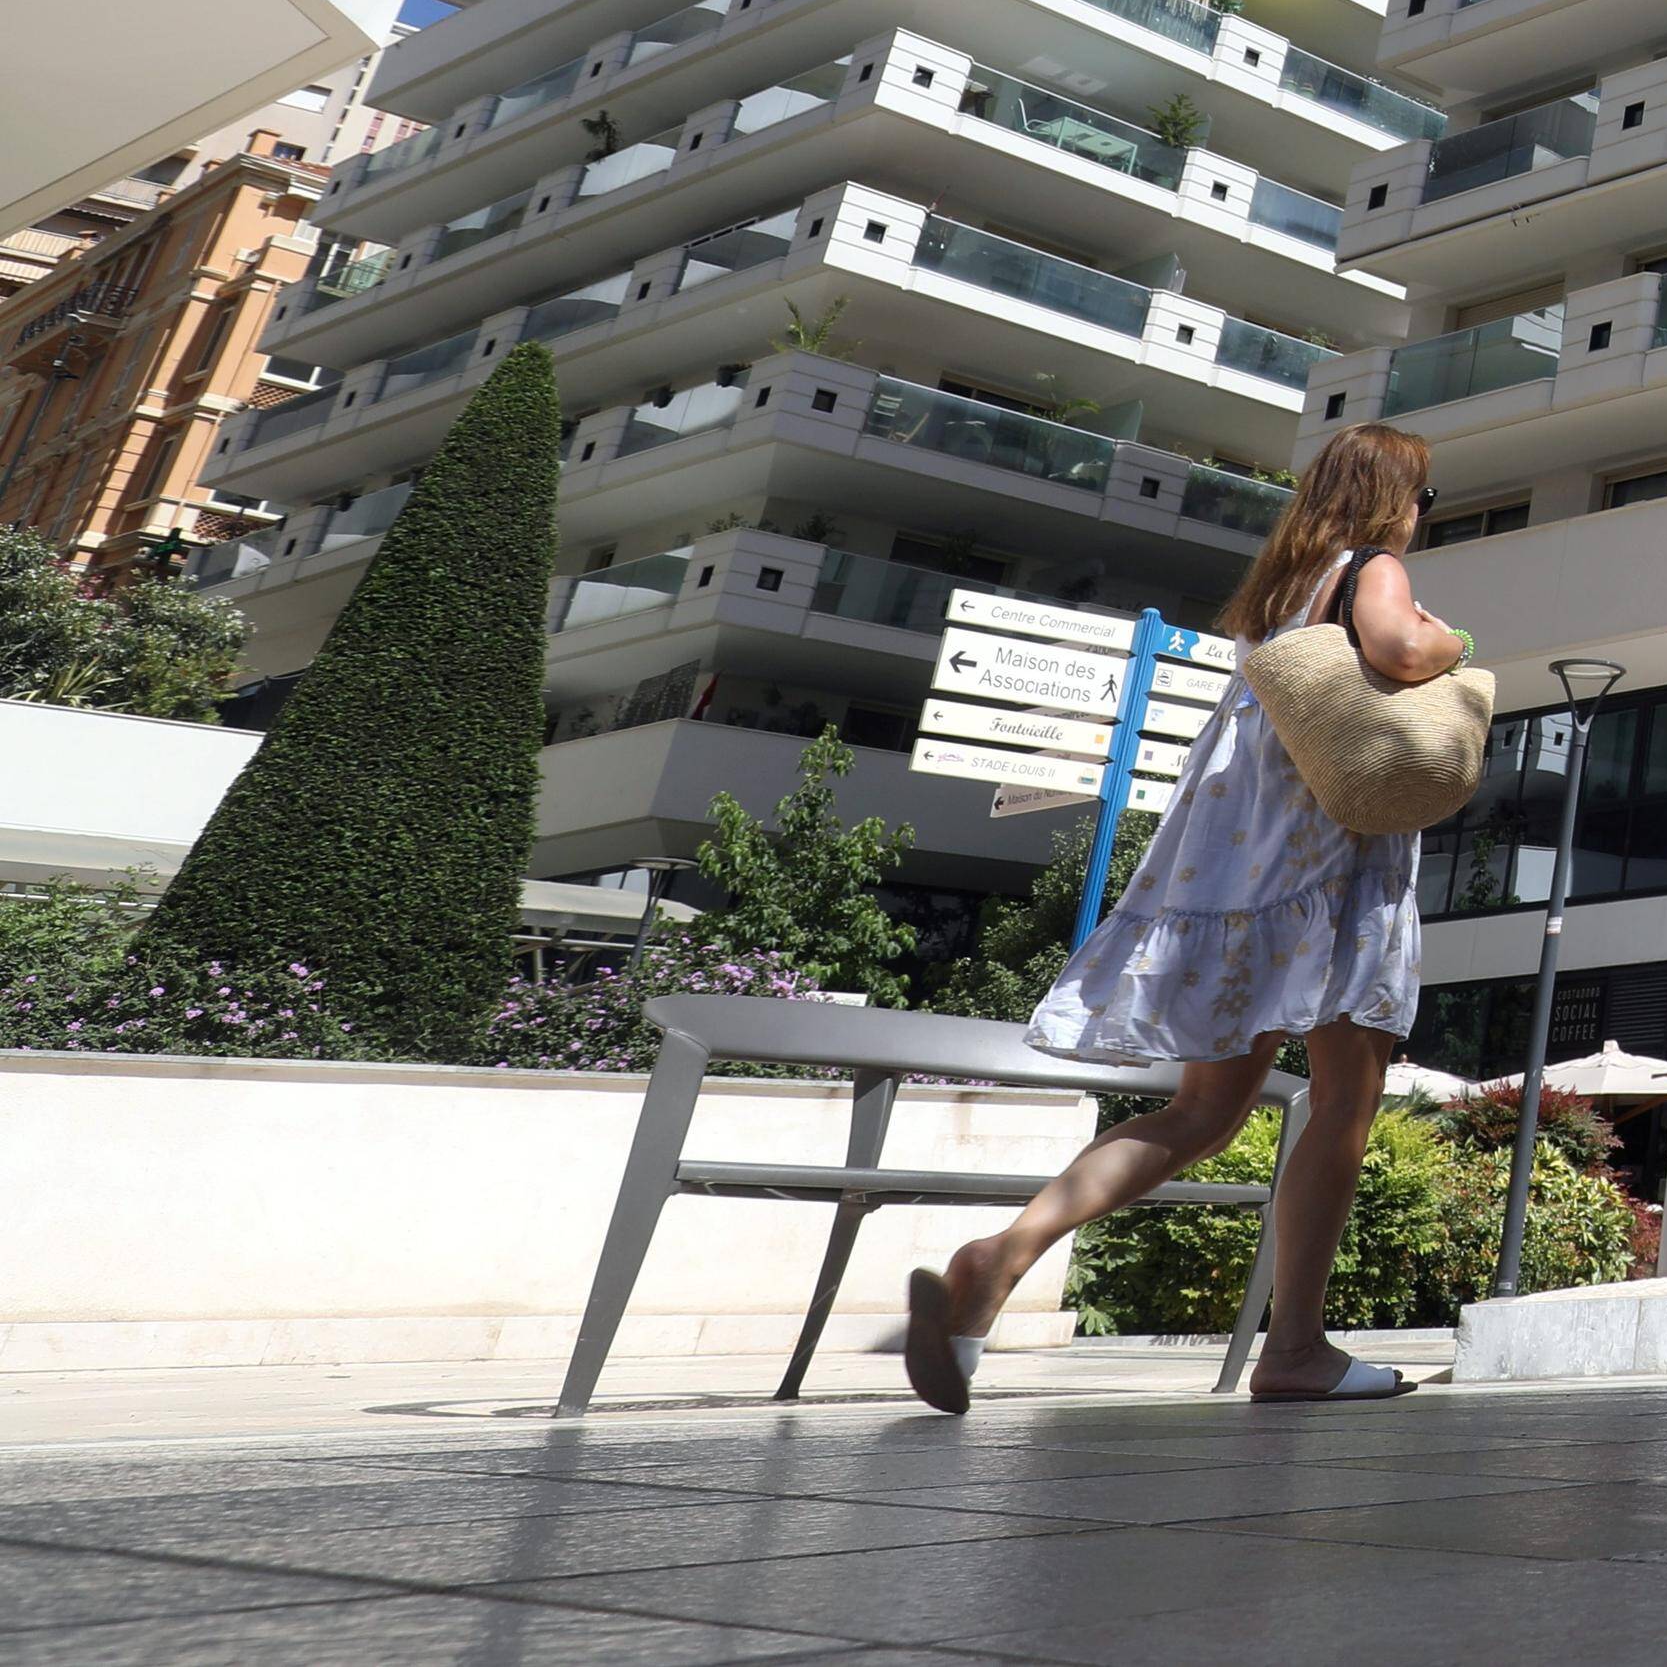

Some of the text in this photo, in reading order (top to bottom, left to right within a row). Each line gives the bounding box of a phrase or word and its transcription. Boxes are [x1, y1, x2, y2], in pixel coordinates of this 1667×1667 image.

[991, 606, 1116, 638] Centre Commercial
[1205, 644, 1223, 659] La
[995, 647, 1059, 673] Maison
[1065, 660, 1096, 680] des
[978, 669, 1091, 703] Associations
[1186, 678, 1214, 691] GARE
[989, 717, 1063, 741] Fontvieille
[971, 757, 1056, 777] STADE LOUIS II
[1554, 1002, 1597, 1022] SOCIAL
[1552, 1023, 1596, 1043] COFFEE
